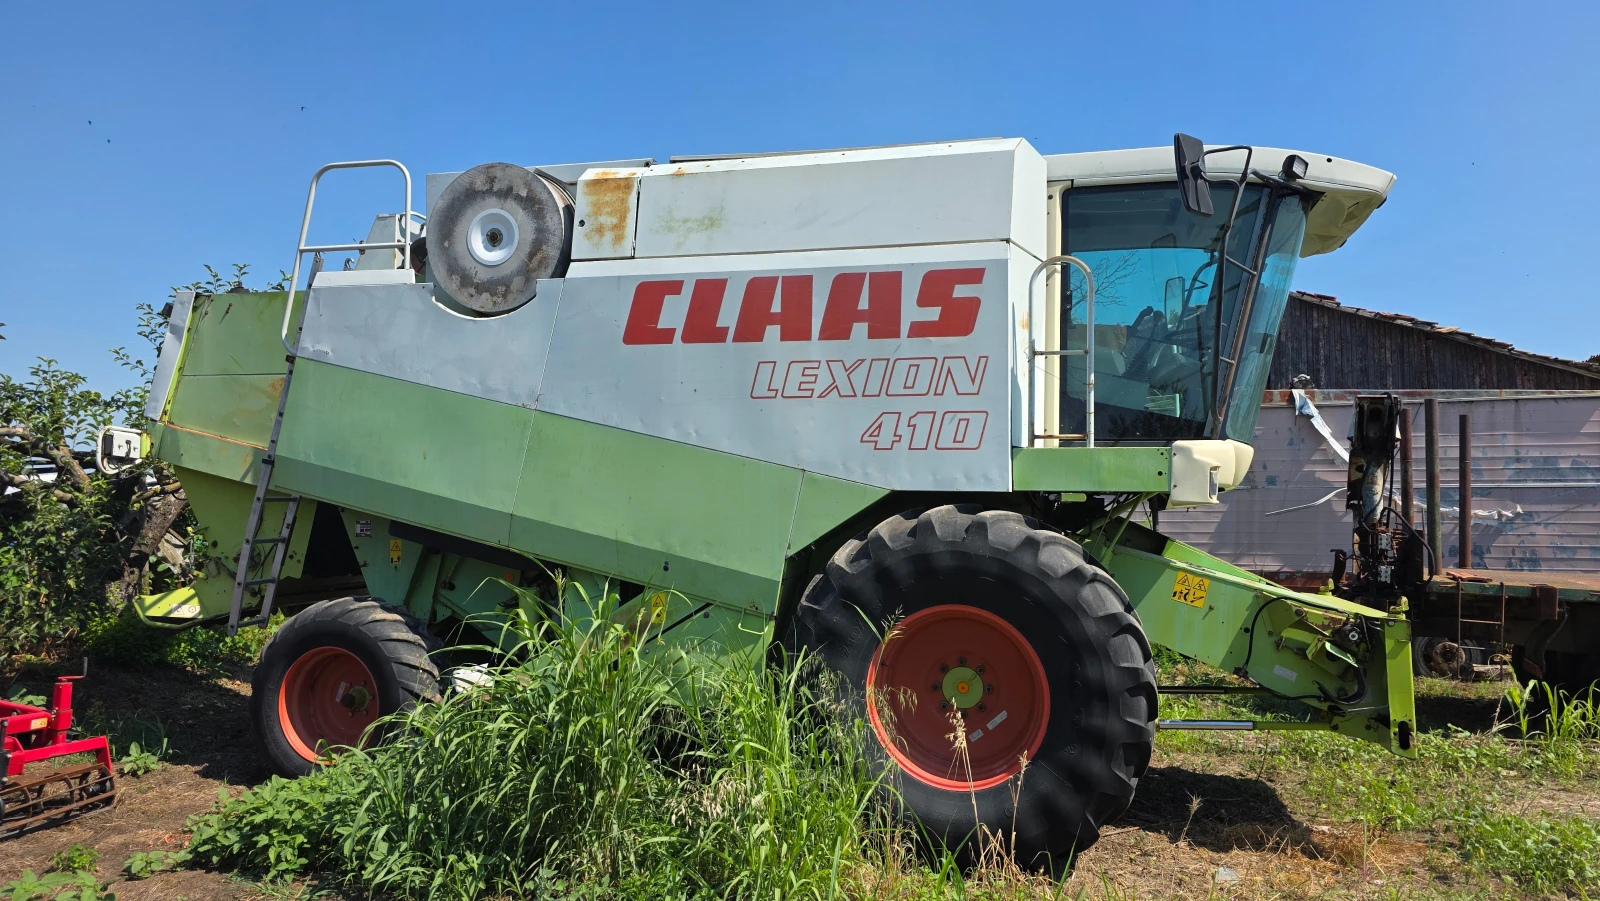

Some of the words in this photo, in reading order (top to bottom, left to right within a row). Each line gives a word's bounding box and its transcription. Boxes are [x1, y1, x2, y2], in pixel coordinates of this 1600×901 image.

[622, 267, 986, 345] CLAAS
[750, 355, 989, 399] LEXION
[860, 410, 989, 450] 410
